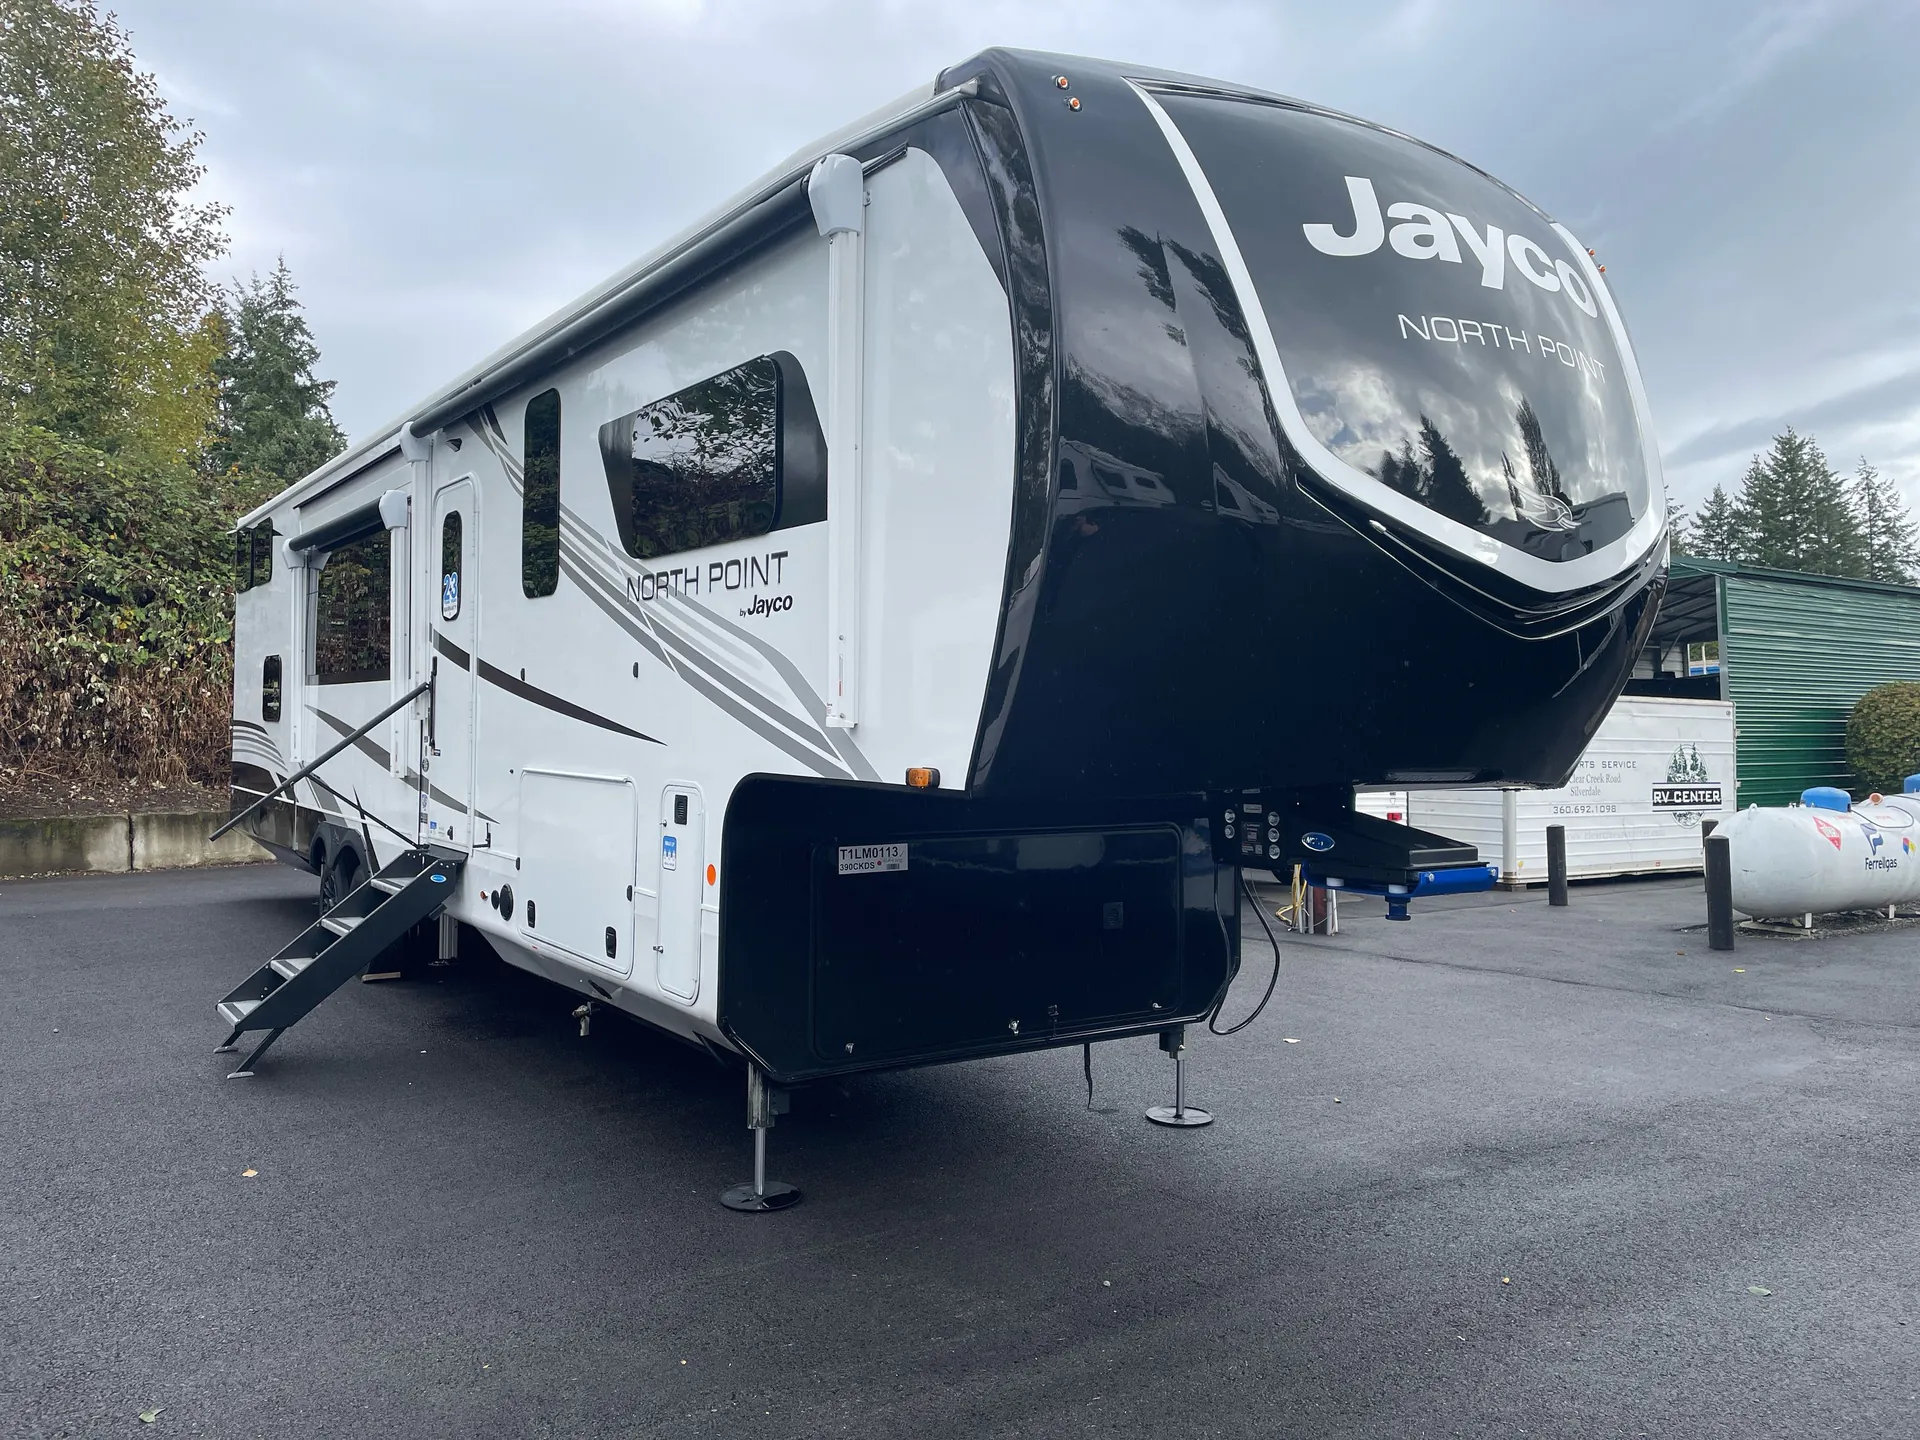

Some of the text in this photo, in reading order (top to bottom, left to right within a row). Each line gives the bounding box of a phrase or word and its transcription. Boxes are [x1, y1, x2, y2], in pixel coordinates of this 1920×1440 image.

[1302, 175, 1598, 318] Jayco
[1397, 314, 1606, 384] NORTH POINT
[626, 550, 789, 604] NORTH POINT
[739, 594, 793, 618] by Jayco
[1601, 760, 1637, 769] SERVICE
[1586, 773, 1605, 784] Creek
[1605, 773, 1621, 784] Road
[1570, 786, 1602, 797] Silverdale
[1653, 790, 1721, 804] RV CENTER
[1553, 805, 1617, 814] 360.692.1098
[839, 846, 899, 860] T1LM0113
[839, 862, 876, 871] 390CKDS
[1864, 856, 1898, 872] Ferrellgas
